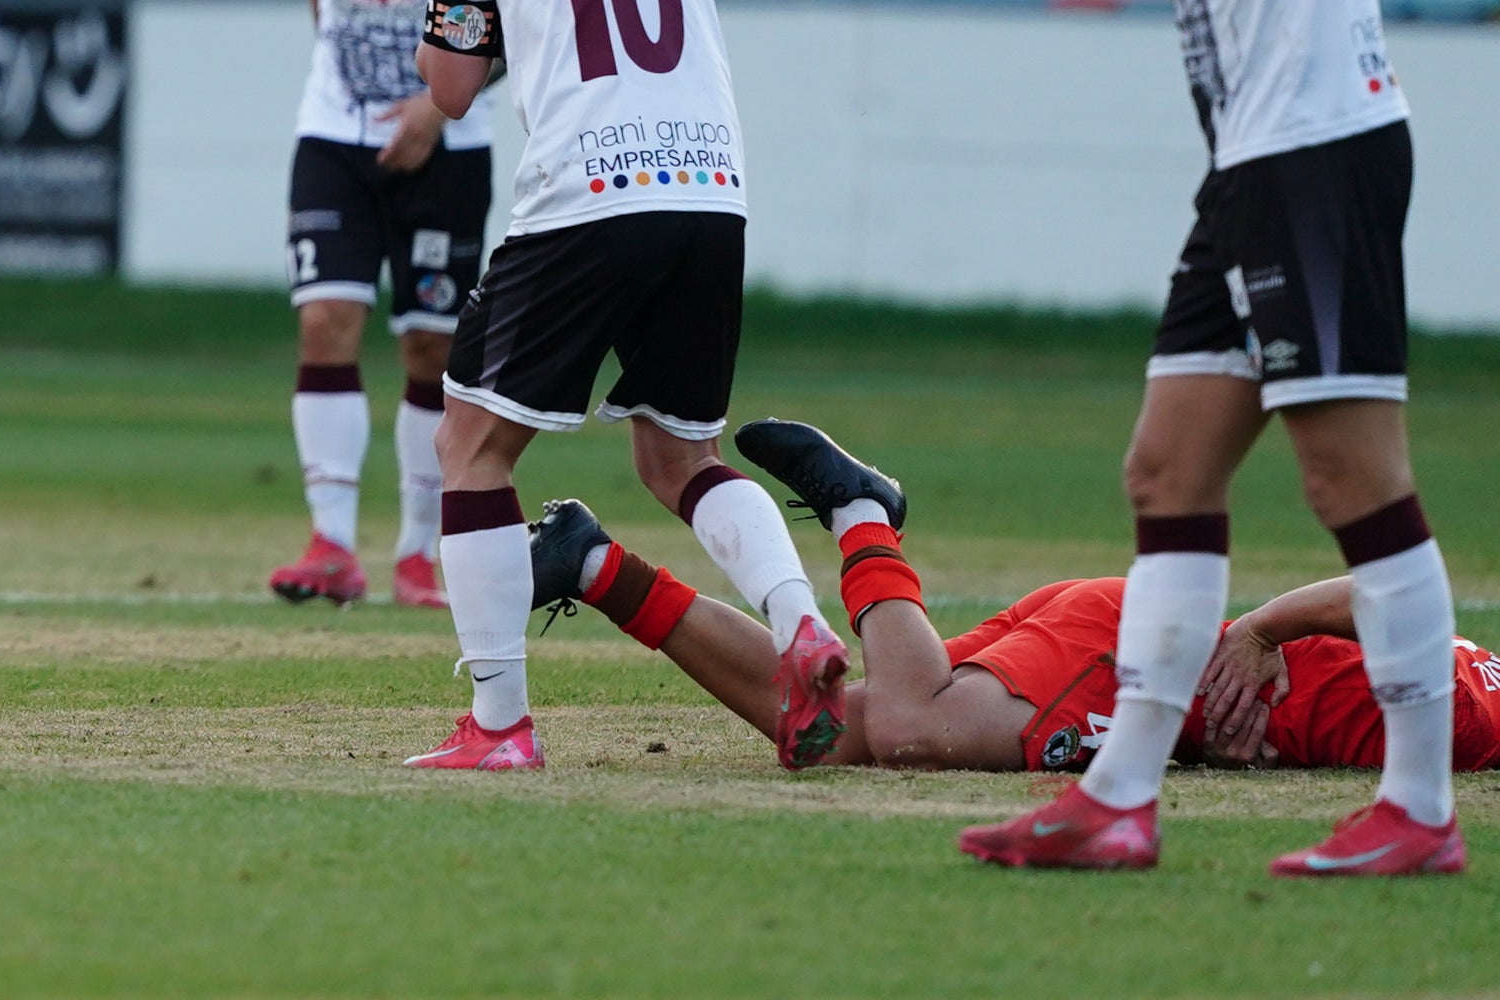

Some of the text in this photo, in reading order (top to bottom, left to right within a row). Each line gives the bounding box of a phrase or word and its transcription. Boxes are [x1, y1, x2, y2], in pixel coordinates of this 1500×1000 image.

[579, 115, 731, 152] nani grupo
[585, 150, 737, 177] EMPRESARIAL
